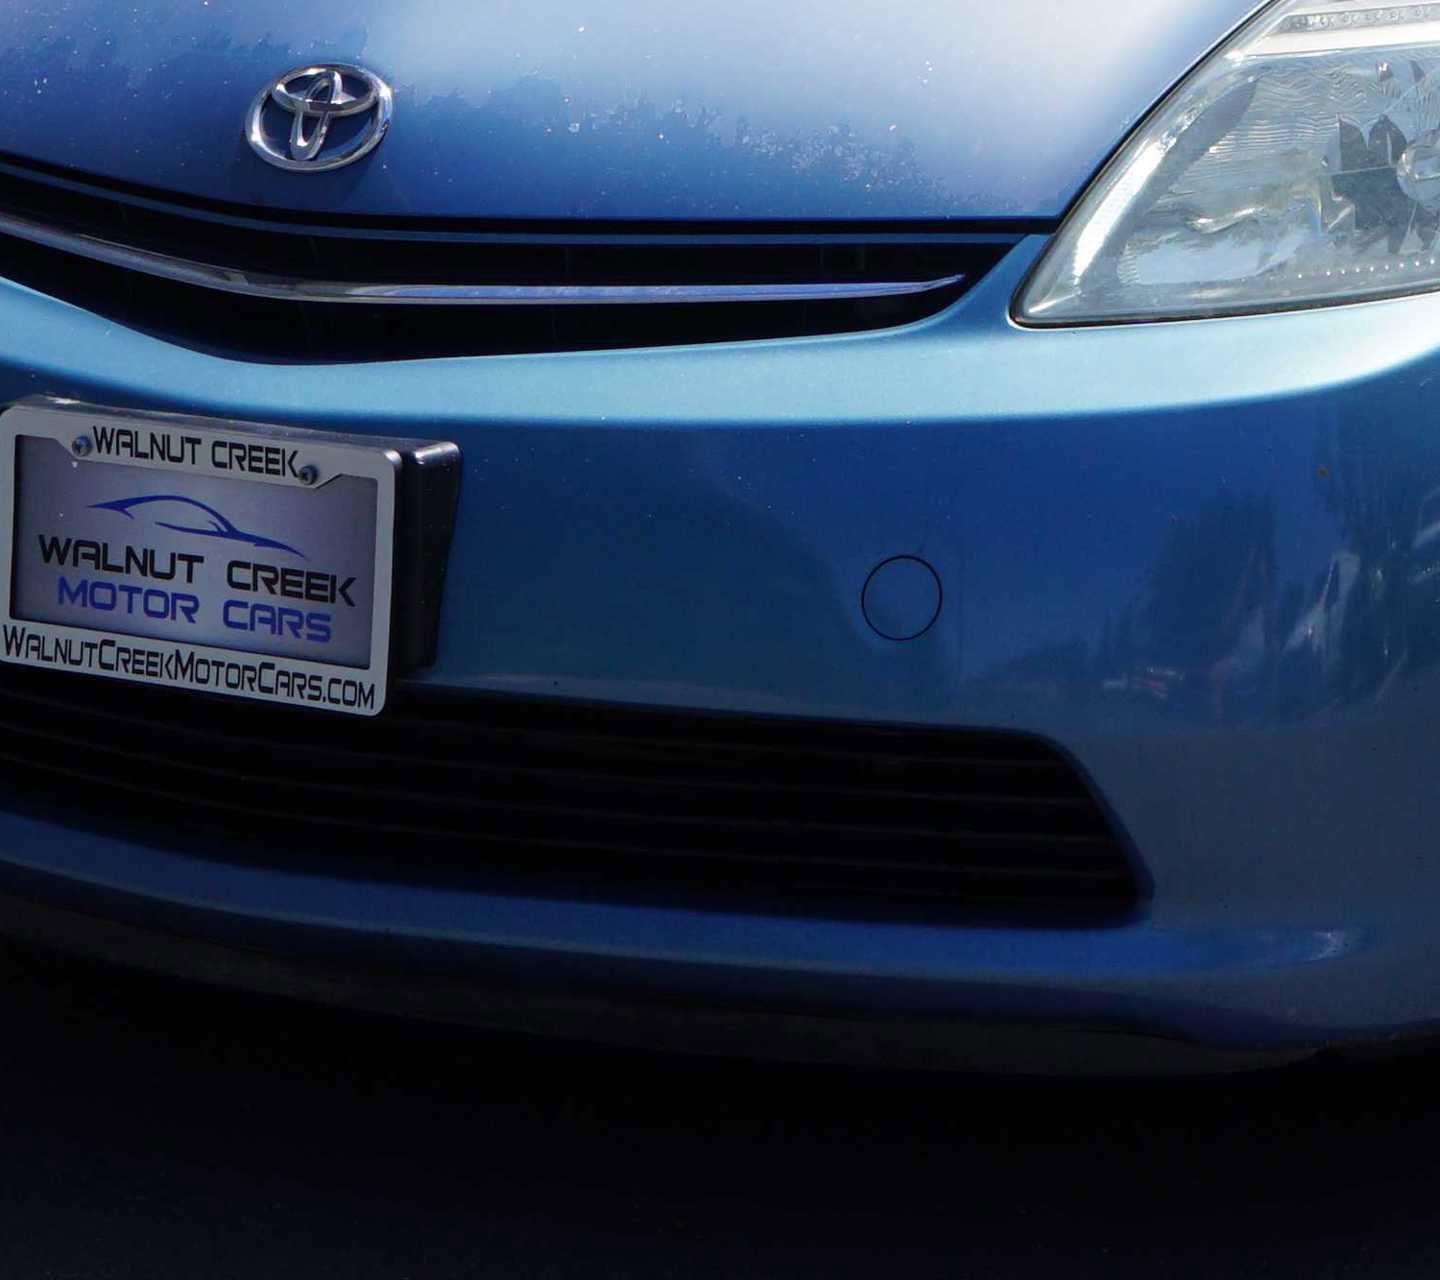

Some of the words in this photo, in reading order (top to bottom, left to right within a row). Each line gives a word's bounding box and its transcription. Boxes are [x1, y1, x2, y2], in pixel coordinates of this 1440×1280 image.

[92, 425, 201, 466] WALNUT
[211, 440, 300, 478] CREEK
[37, 534, 204, 584] WALNUT
[226, 560, 358, 607] CREEK
[57, 577, 200, 624] MOTOR
[222, 600, 331, 643] CARS
